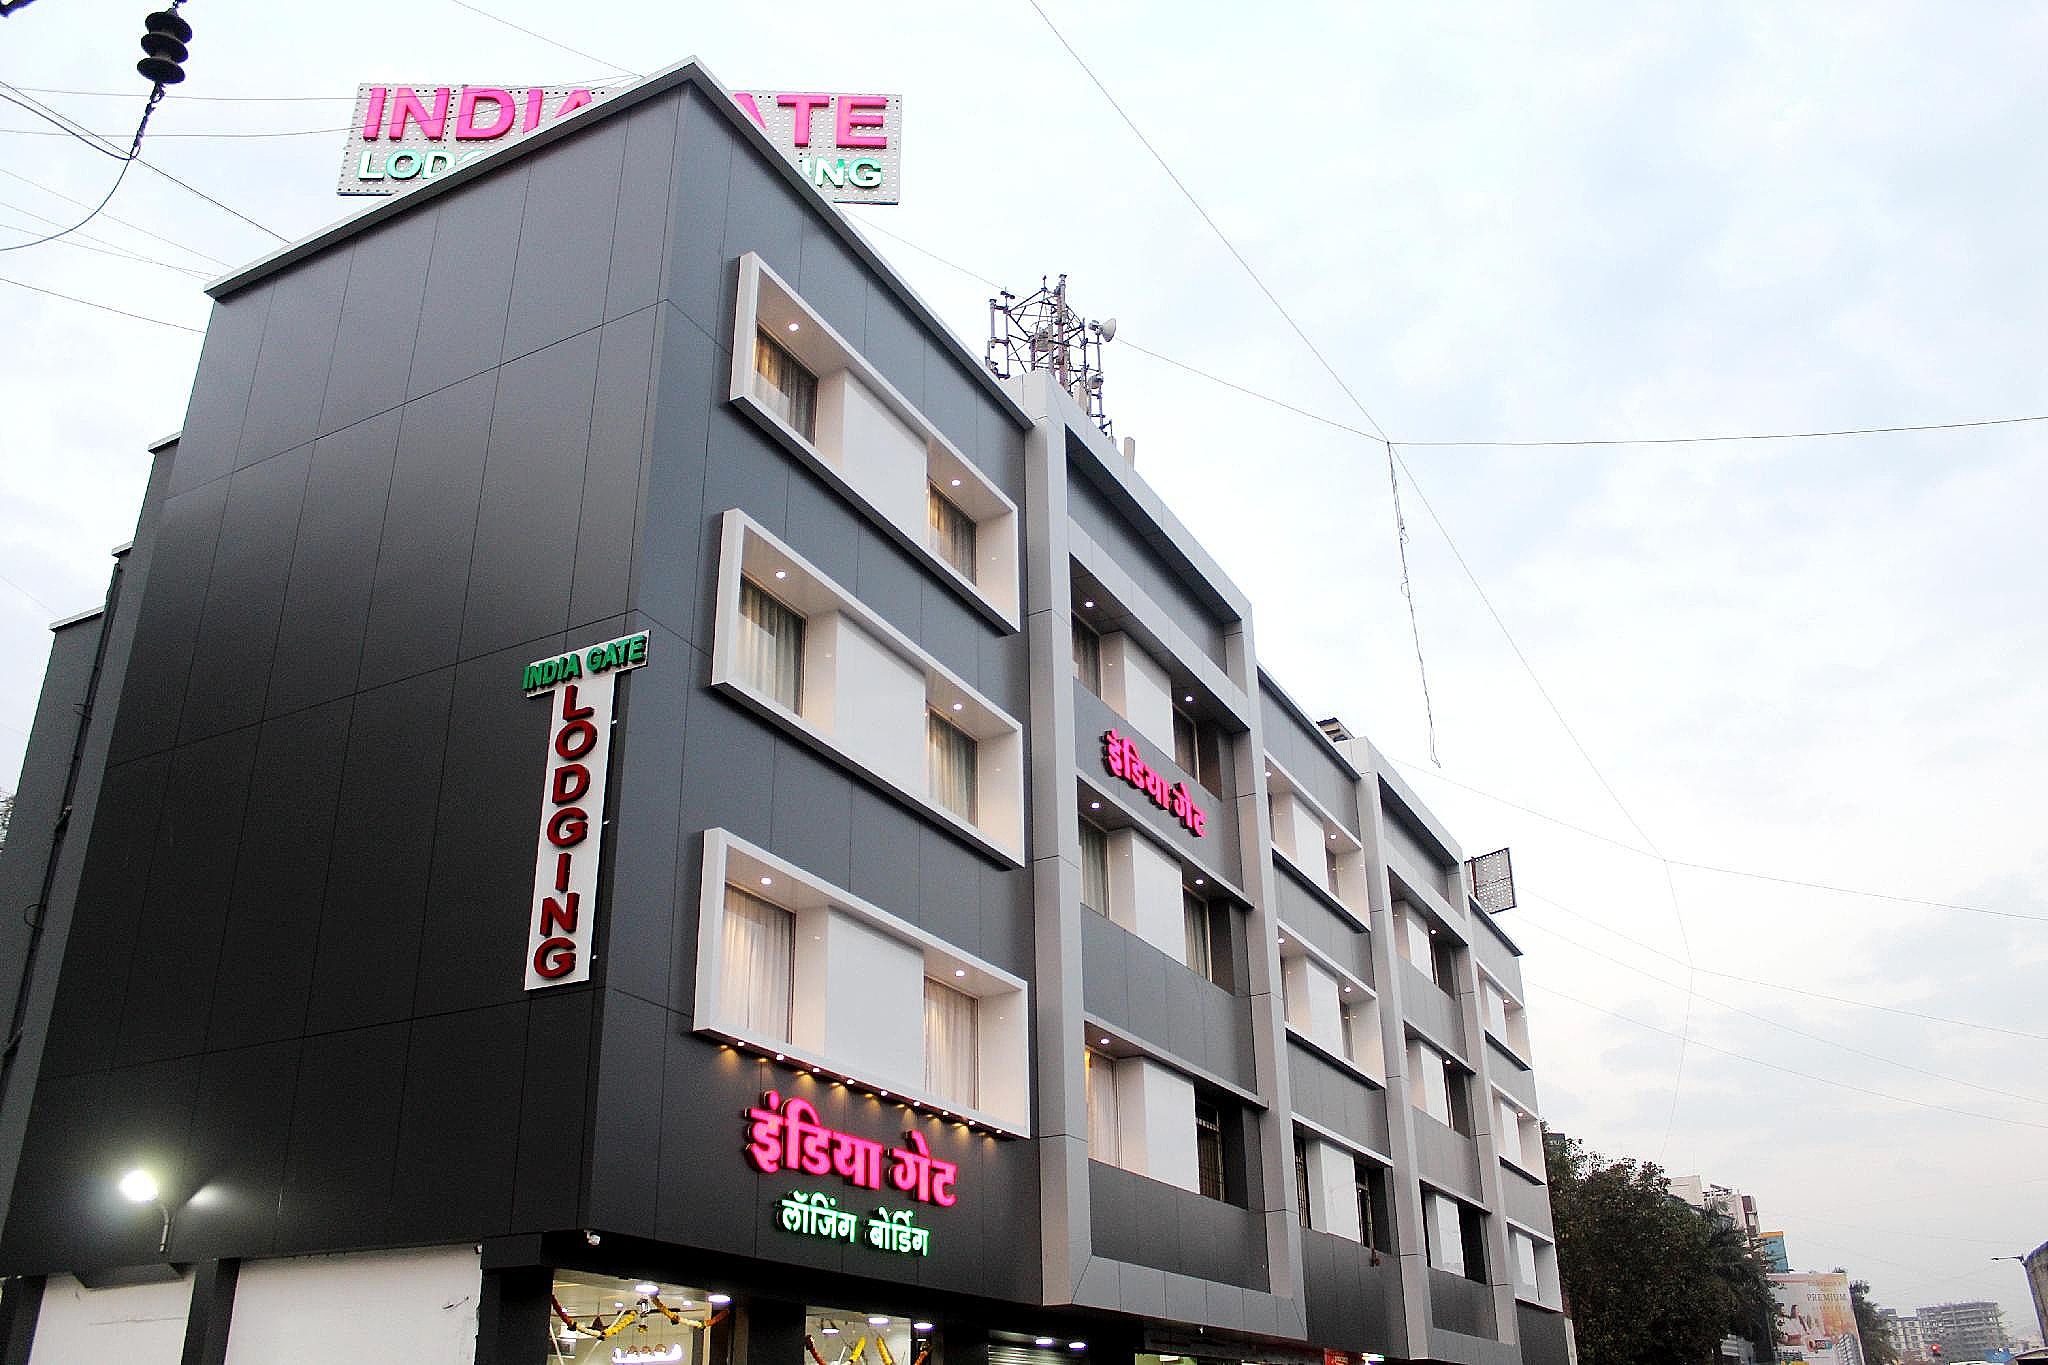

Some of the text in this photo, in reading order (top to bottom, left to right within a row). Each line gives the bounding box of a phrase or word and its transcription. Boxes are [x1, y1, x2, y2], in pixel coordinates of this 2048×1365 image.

[358, 149, 482, 180] LOD
[522, 635, 647, 691] INDIA GATE
[1102, 728, 1206, 838] इंडिया गेट
[533, 683, 598, 980] LODGING
[748, 1089, 958, 1207] इंडिया गेट
[781, 1190, 858, 1243] लॉजिंग
